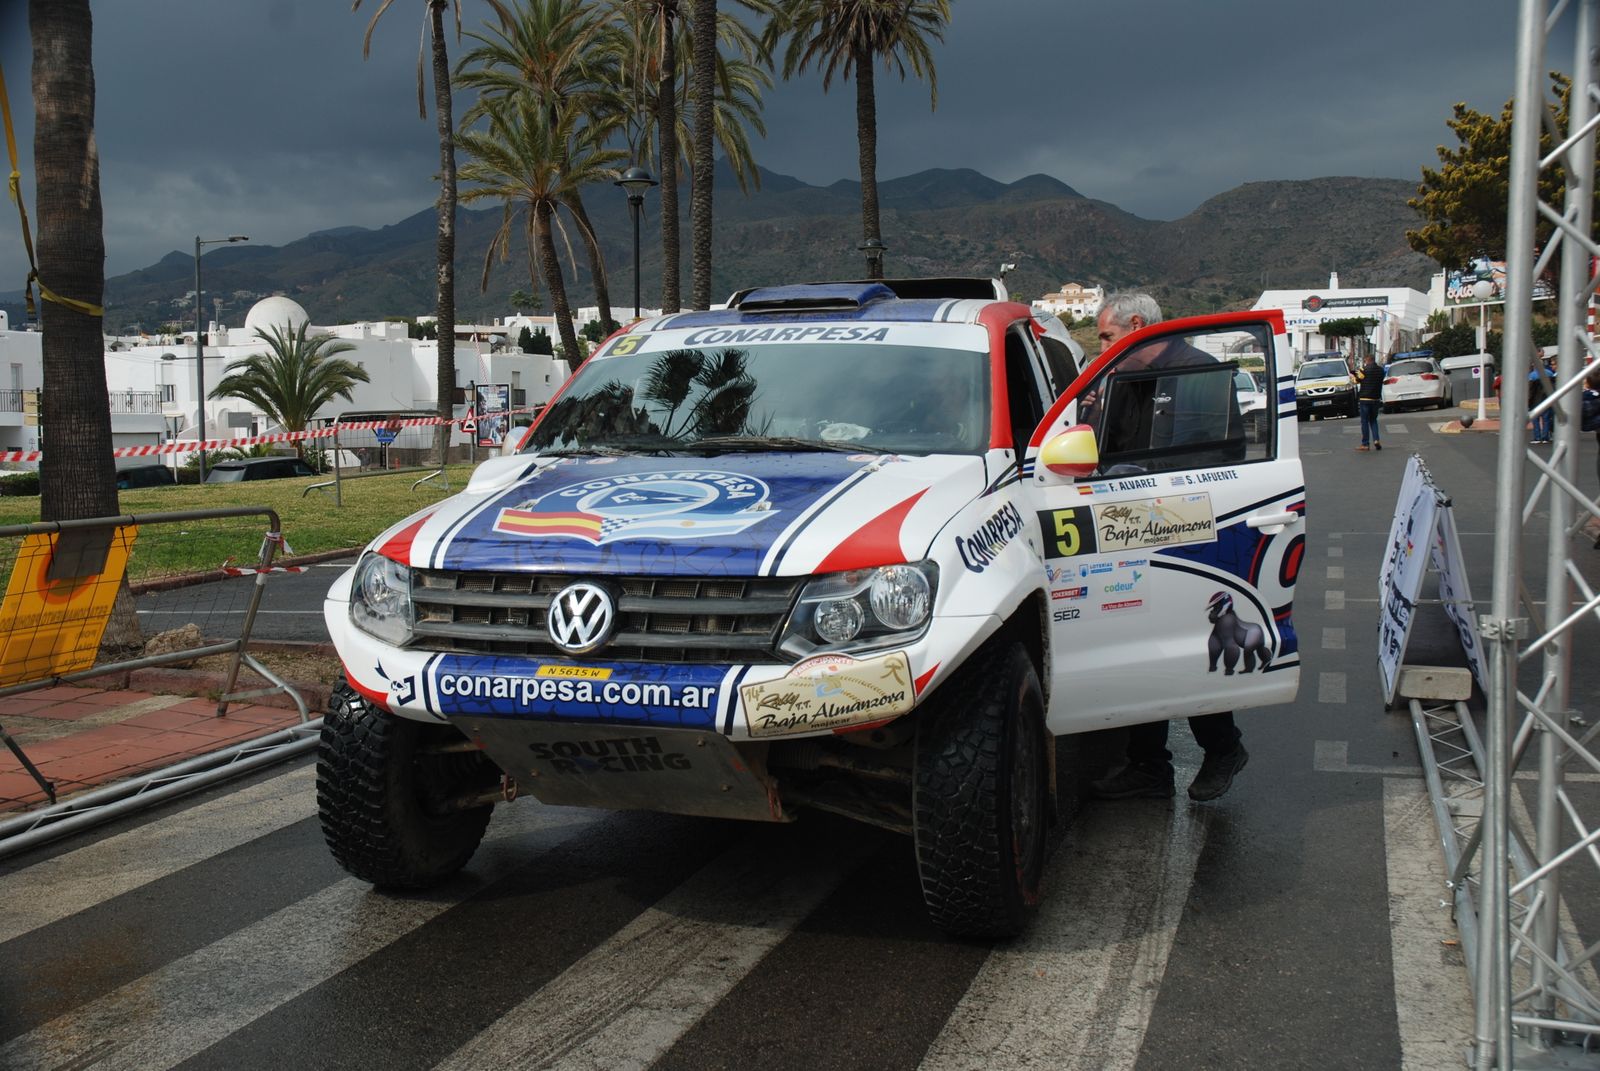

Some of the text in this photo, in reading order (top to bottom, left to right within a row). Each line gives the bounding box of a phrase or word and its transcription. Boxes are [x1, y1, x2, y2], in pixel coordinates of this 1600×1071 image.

[612, 336, 639, 357] 5
[683, 326, 890, 346] CONARPESA
[559, 471, 757, 500] CONARPESA
[1108, 469, 1239, 492] F. ALVAREZ S. LAFUENTE
[954, 500, 1025, 574] CONARPESA
[1051, 508, 1083, 558] 5
[1099, 518, 1212, 546] Baja Almanzora
[1104, 582, 1134, 592] codeur
[559, 668, 589, 677] 5615
[439, 674, 717, 709] conarpesa.com.ar
[755, 690, 904, 729] Baja Almanzora
[529, 736, 664, 760] SOUTH
